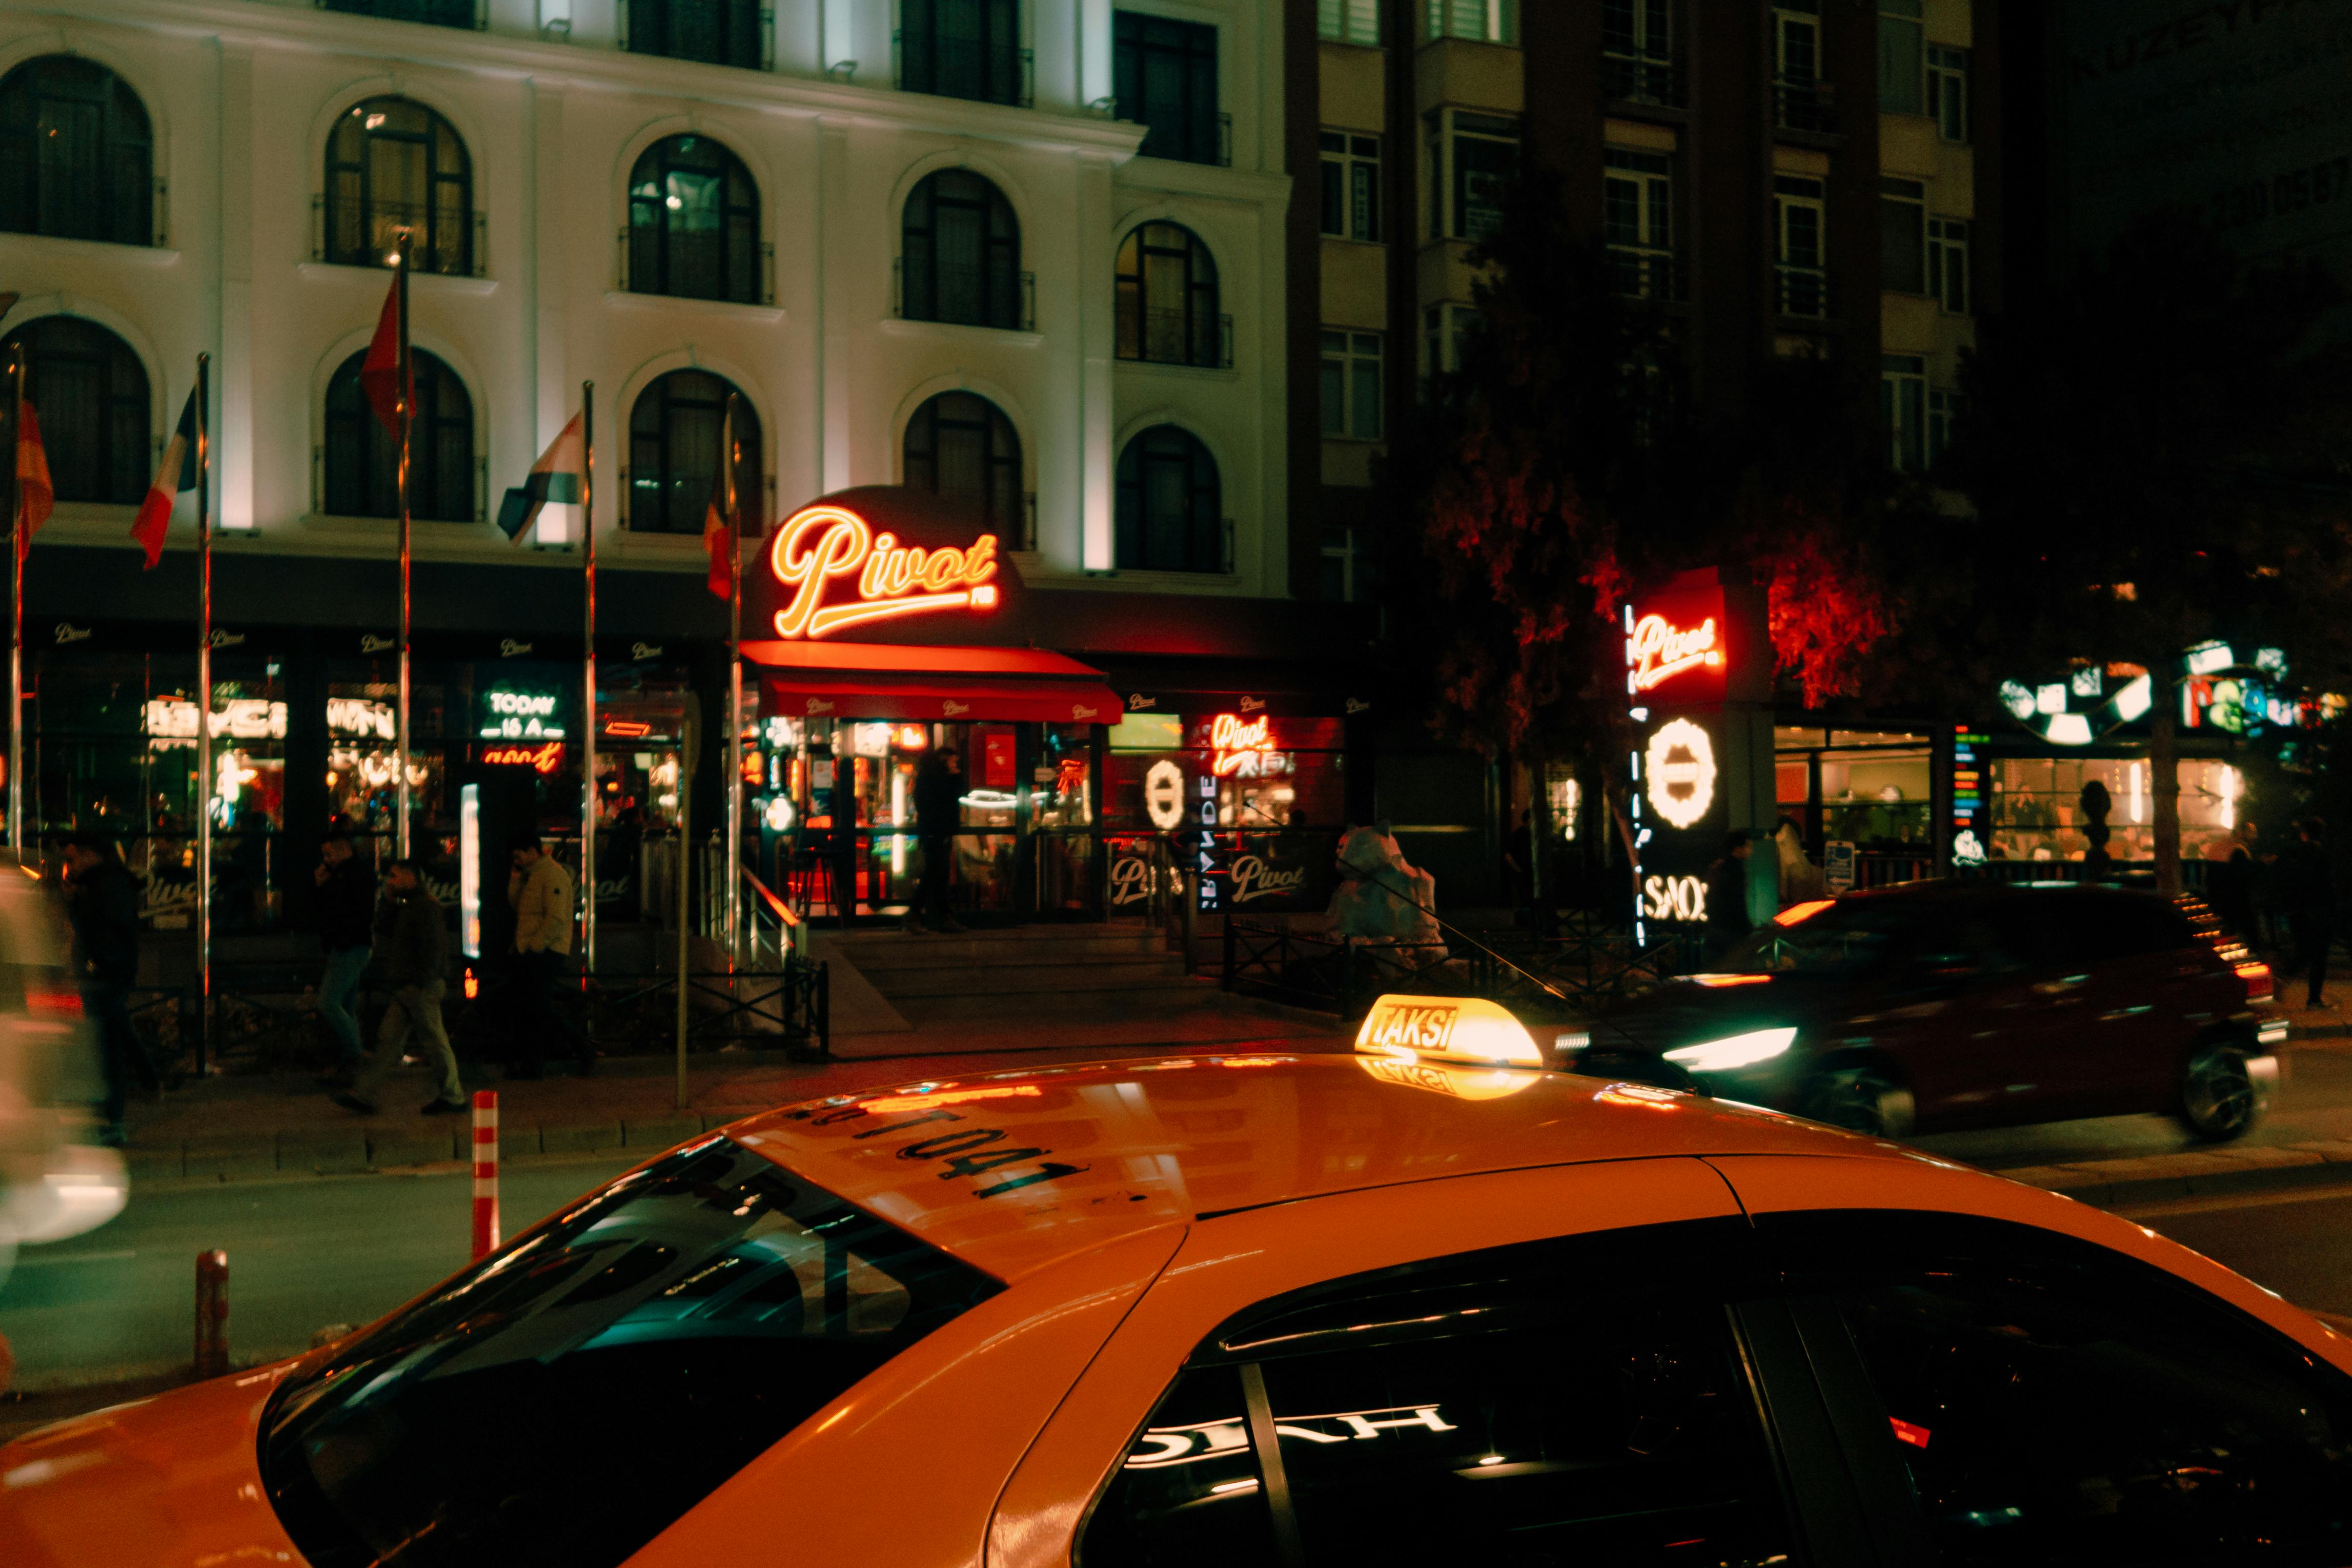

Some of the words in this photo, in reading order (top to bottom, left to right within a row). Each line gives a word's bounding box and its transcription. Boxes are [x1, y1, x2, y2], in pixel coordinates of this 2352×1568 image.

[2070, 0, 2296, 84] KUZEYP
[773, 506, 998, 638] Pivot
[1632, 615, 1714, 686] Pivot
[491, 693, 555, 715] TODAY
[502, 718, 522, 737] IS
[525, 718, 542, 736] A
[1212, 714, 1269, 775] Pivot
[1231, 855, 1304, 902] Pivot
